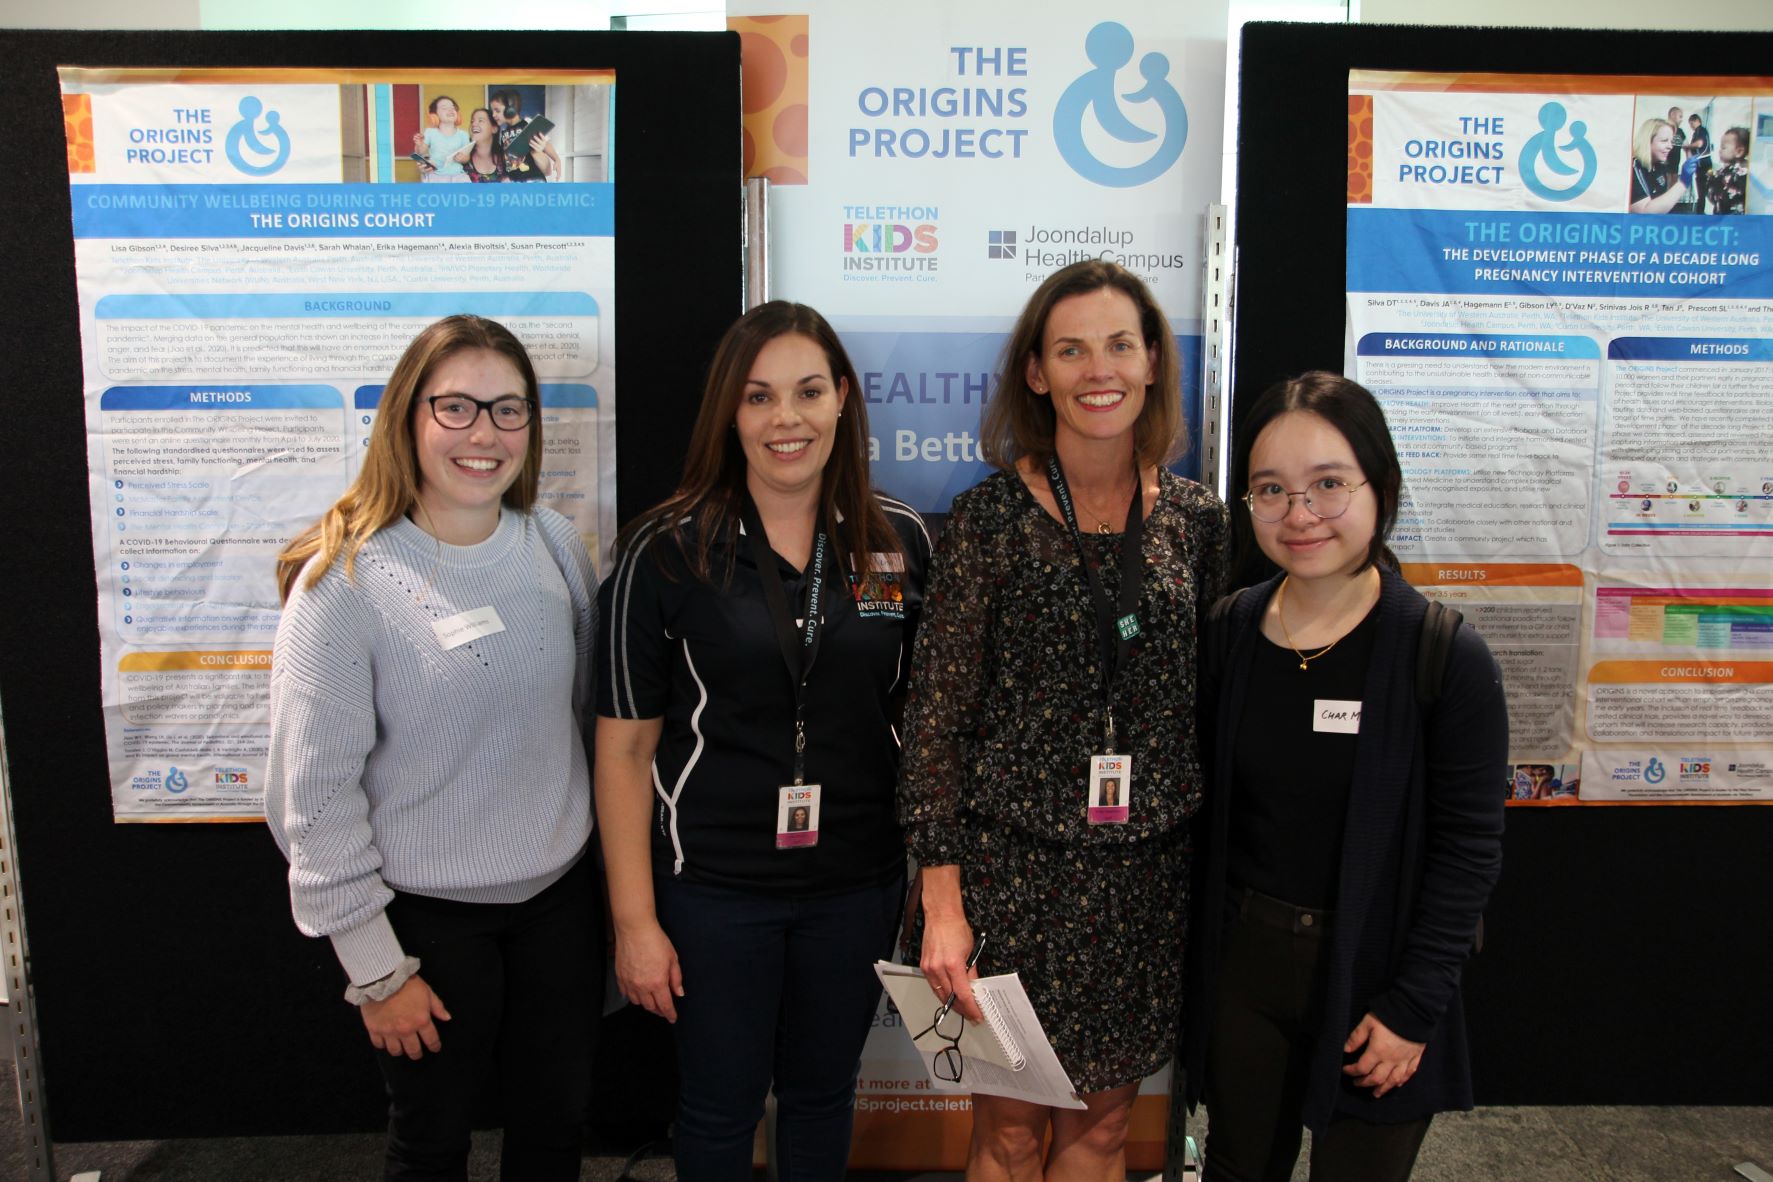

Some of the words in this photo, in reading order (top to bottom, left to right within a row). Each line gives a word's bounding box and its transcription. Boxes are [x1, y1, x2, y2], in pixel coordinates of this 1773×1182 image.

[951, 47, 1027, 76] THE
[858, 87, 1028, 117] ORIGINS
[173, 109, 211, 124] THE
[1459, 117, 1504, 136] THE
[129, 128, 213, 144] ORIGINS
[849, 129, 1028, 158] PROJECT
[1404, 140, 1504, 160] ORIGINS
[126, 149, 213, 164] PROJECT
[1399, 165, 1504, 185] PROJECT
[88, 195, 198, 209] COMMUNITY
[204, 194, 301, 208] WELLBEING
[307, 194, 374, 208] DURING
[380, 194, 412, 208] THE
[417, 194, 495, 208] COVID-19
[500, 194, 596, 208] PANDEMIC:
[844, 206, 938, 221] TELETHON
[250, 214, 282, 228] THE
[288, 214, 360, 228] ORIGINS
[364, 214, 434, 228] COHORT
[844, 224, 939, 254] KIDS
[1025, 226, 1134, 248] Joondalup
[1465, 222, 1512, 242] THE
[1519, 223, 1622, 244] ORIGINS
[1630, 225, 1739, 246] PROJECT:
[112, 244, 126, 252] Lisa
[170, 244, 200, 252] Desiree
[240, 244, 282, 253] Jacqueline
[319, 243, 340, 251] Sarah
[1026, 248, 1091, 267] Health
[1100, 250, 1184, 272] Campus
[1443, 248, 1468, 261] THE
[1473, 250, 1576, 263] DEVELOPMENT
[1580, 251, 1624, 264] PHASE
[1628, 252, 1646, 264] OF
[1650, 252, 1660, 264] A
[1664, 252, 1718, 265] DECADE
[1721, 254, 1760, 266] LONG
[844, 257, 938, 272] INSTITUTE
[844, 274, 879, 282] Discover.
[881, 274, 914, 282] Prevent.
[916, 274, 938, 282] Cure.
[1026, 273, 1045, 282] Part
[1474, 268, 1558, 282] PREGNANCY
[1562, 270, 1665, 284] INTERVENTION
[1669, 272, 1726, 284] COHORT
[304, 300, 392, 312] BACKGROUND
[1420, 300, 1440, 308] Davis
[1464, 301, 1502, 310] Hagemann
[1662, 304, 1674, 312] Tan
[1385, 339, 1468, 352] BACKGROUND
[1470, 340, 1496, 352] AND
[1500, 341, 1565, 352] RATIONALE
[1690, 344, 1749, 354] METHODS
[864, 372, 1002, 404] EALTH
[1379, 388, 1405, 396] ORIGINS
[1406, 388, 1428, 396] Project
[1442, 390, 1478, 398] pregnancy
[190, 392, 252, 402] METHODS
[127, 447, 160, 456] following
[162, 446, 210, 454] standardised
[212, 447, 265, 456] questionnaires
[114, 458, 151, 466] perceived
[153, 458, 176, 466] stress,
[177, 458, 200, 466] family
[301, 456, 316, 464] and
[114, 468, 146, 476] financial
[814, 532, 828, 574] Discover.
[1438, 570, 1486, 580] RESULTS
[810, 576, 822, 617] Prevent.
[857, 601, 904, 612] INSTITUTE
[1120, 615, 1136, 628] SHE
[804, 620, 817, 647] Cure.
[1122, 626, 1138, 638] HER
[200, 655, 273, 665] CONCLUSION
[127, 674, 164, 682] COVID-19
[1660, 667, 1734, 678] CONCLUSION
[1321, 710, 1347, 720] CHAR
[1098, 762, 1122, 770] KIDS
[1680, 764, 1711, 773] KIDS
[216, 773, 248, 784] KIDS
[787, 792, 812, 800] KIDS
[871, 1012, 902, 1028] ea
[869, 1079, 910, 1090] more
[914, 1078, 931, 1090] at
